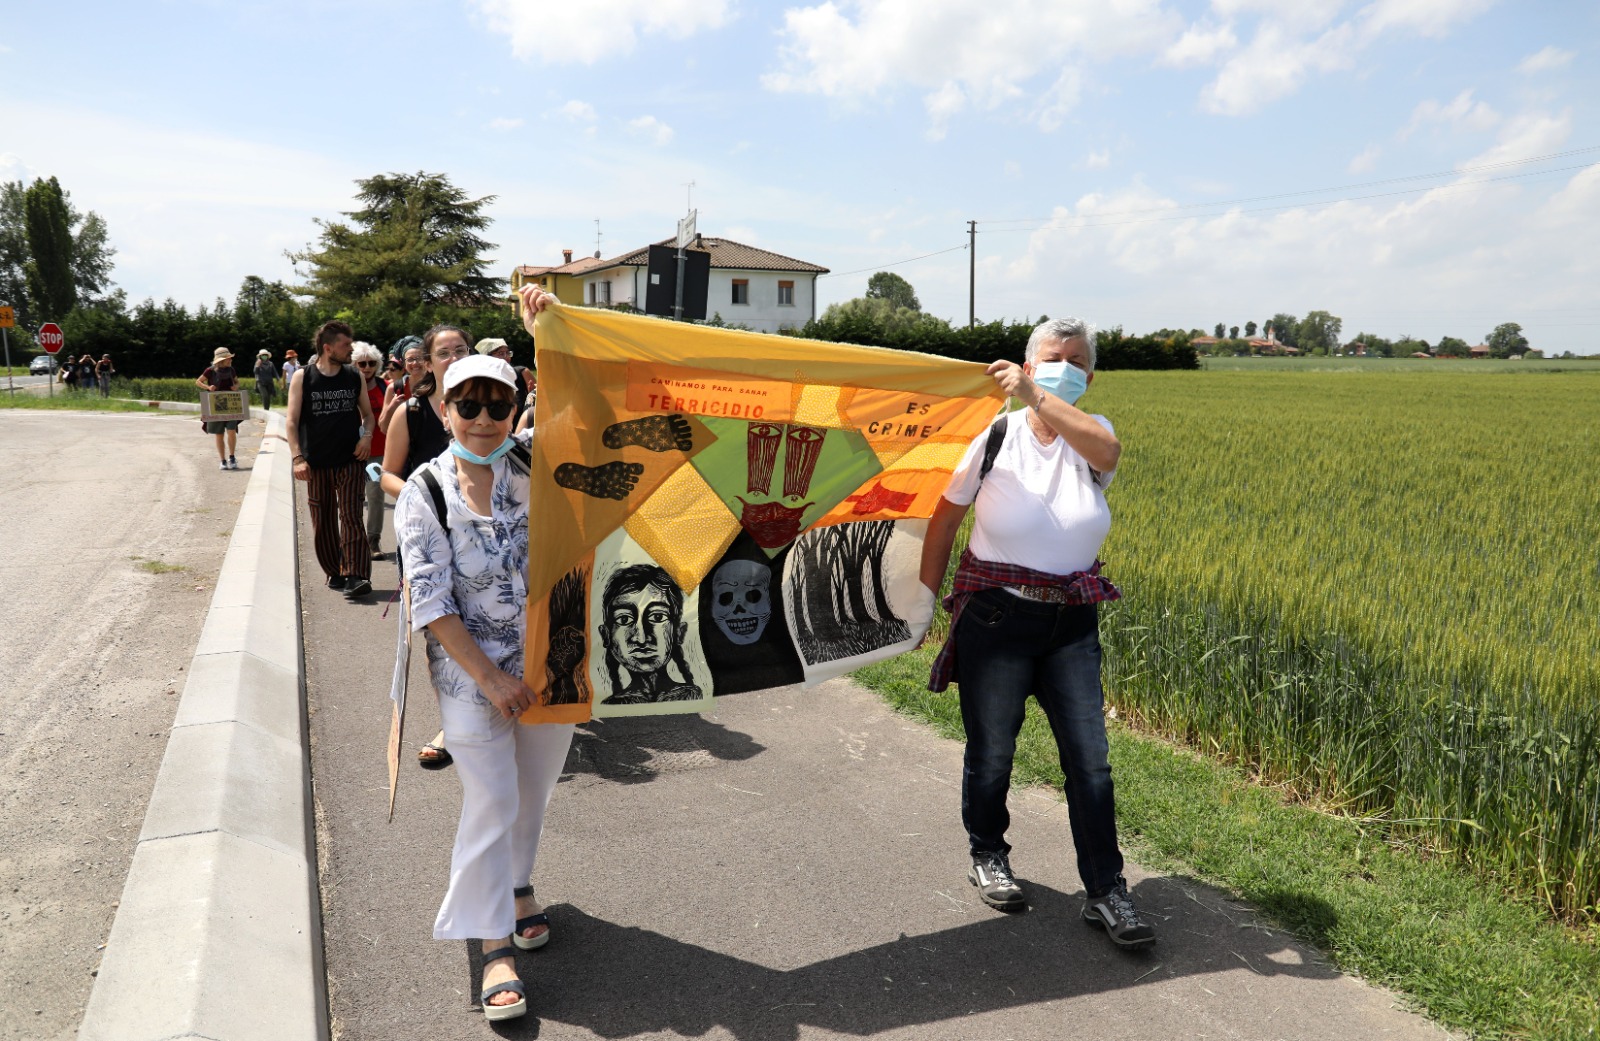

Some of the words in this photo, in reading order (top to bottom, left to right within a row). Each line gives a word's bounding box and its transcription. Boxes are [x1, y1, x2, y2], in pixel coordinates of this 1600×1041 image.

[40, 332, 62, 344] STOP
[651, 378, 706, 390] CAMINAMOS
[712, 384, 733, 393] PARA
[739, 388, 768, 397] SANAR
[324, 400, 341, 410] HAY
[648, 394, 764, 418] TERRICIDIO
[906, 402, 930, 415] ES
[868, 421, 942, 438] CRIME
